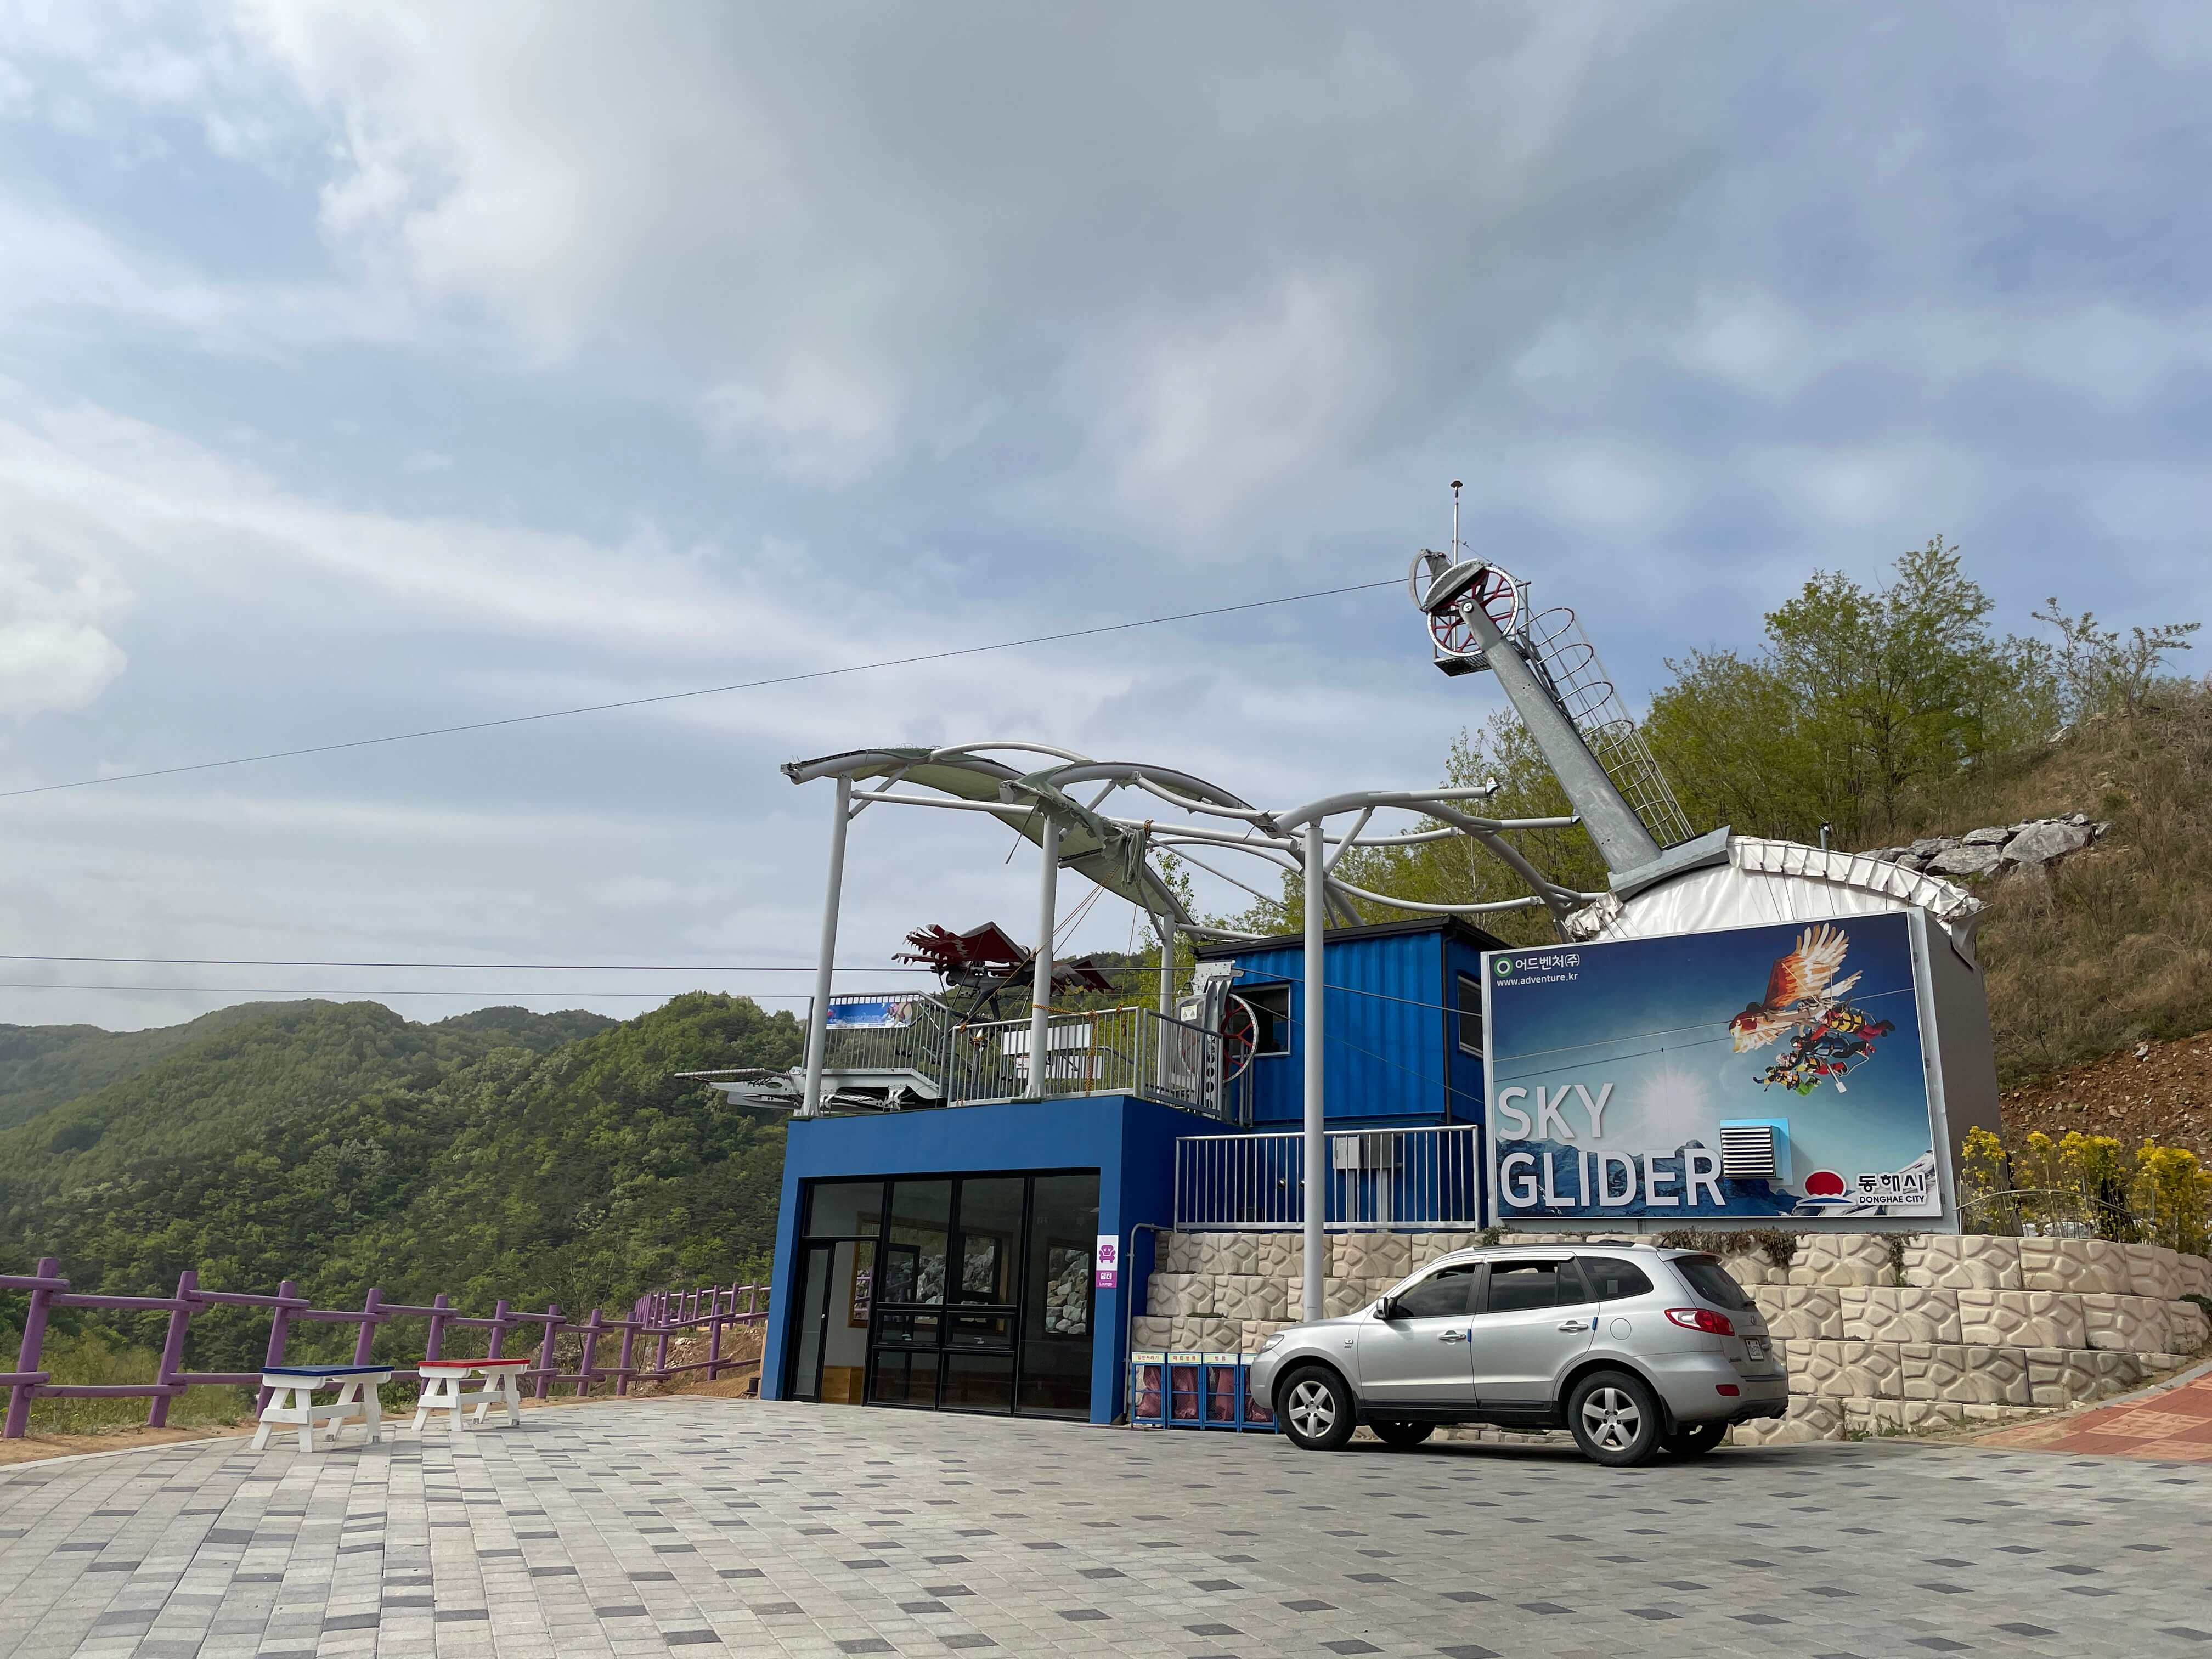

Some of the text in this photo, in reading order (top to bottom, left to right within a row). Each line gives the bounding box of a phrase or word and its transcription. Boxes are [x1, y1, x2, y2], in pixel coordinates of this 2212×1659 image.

[1515, 953, 1580, 971] 어드벤처(주)
[1497, 972, 1578, 986] www.adventure.kr
[1498, 1083, 1614, 1141] SKY
[1500, 1148, 1726, 1207] GLIDER
[1858, 1175, 1923, 1193] 동해시
